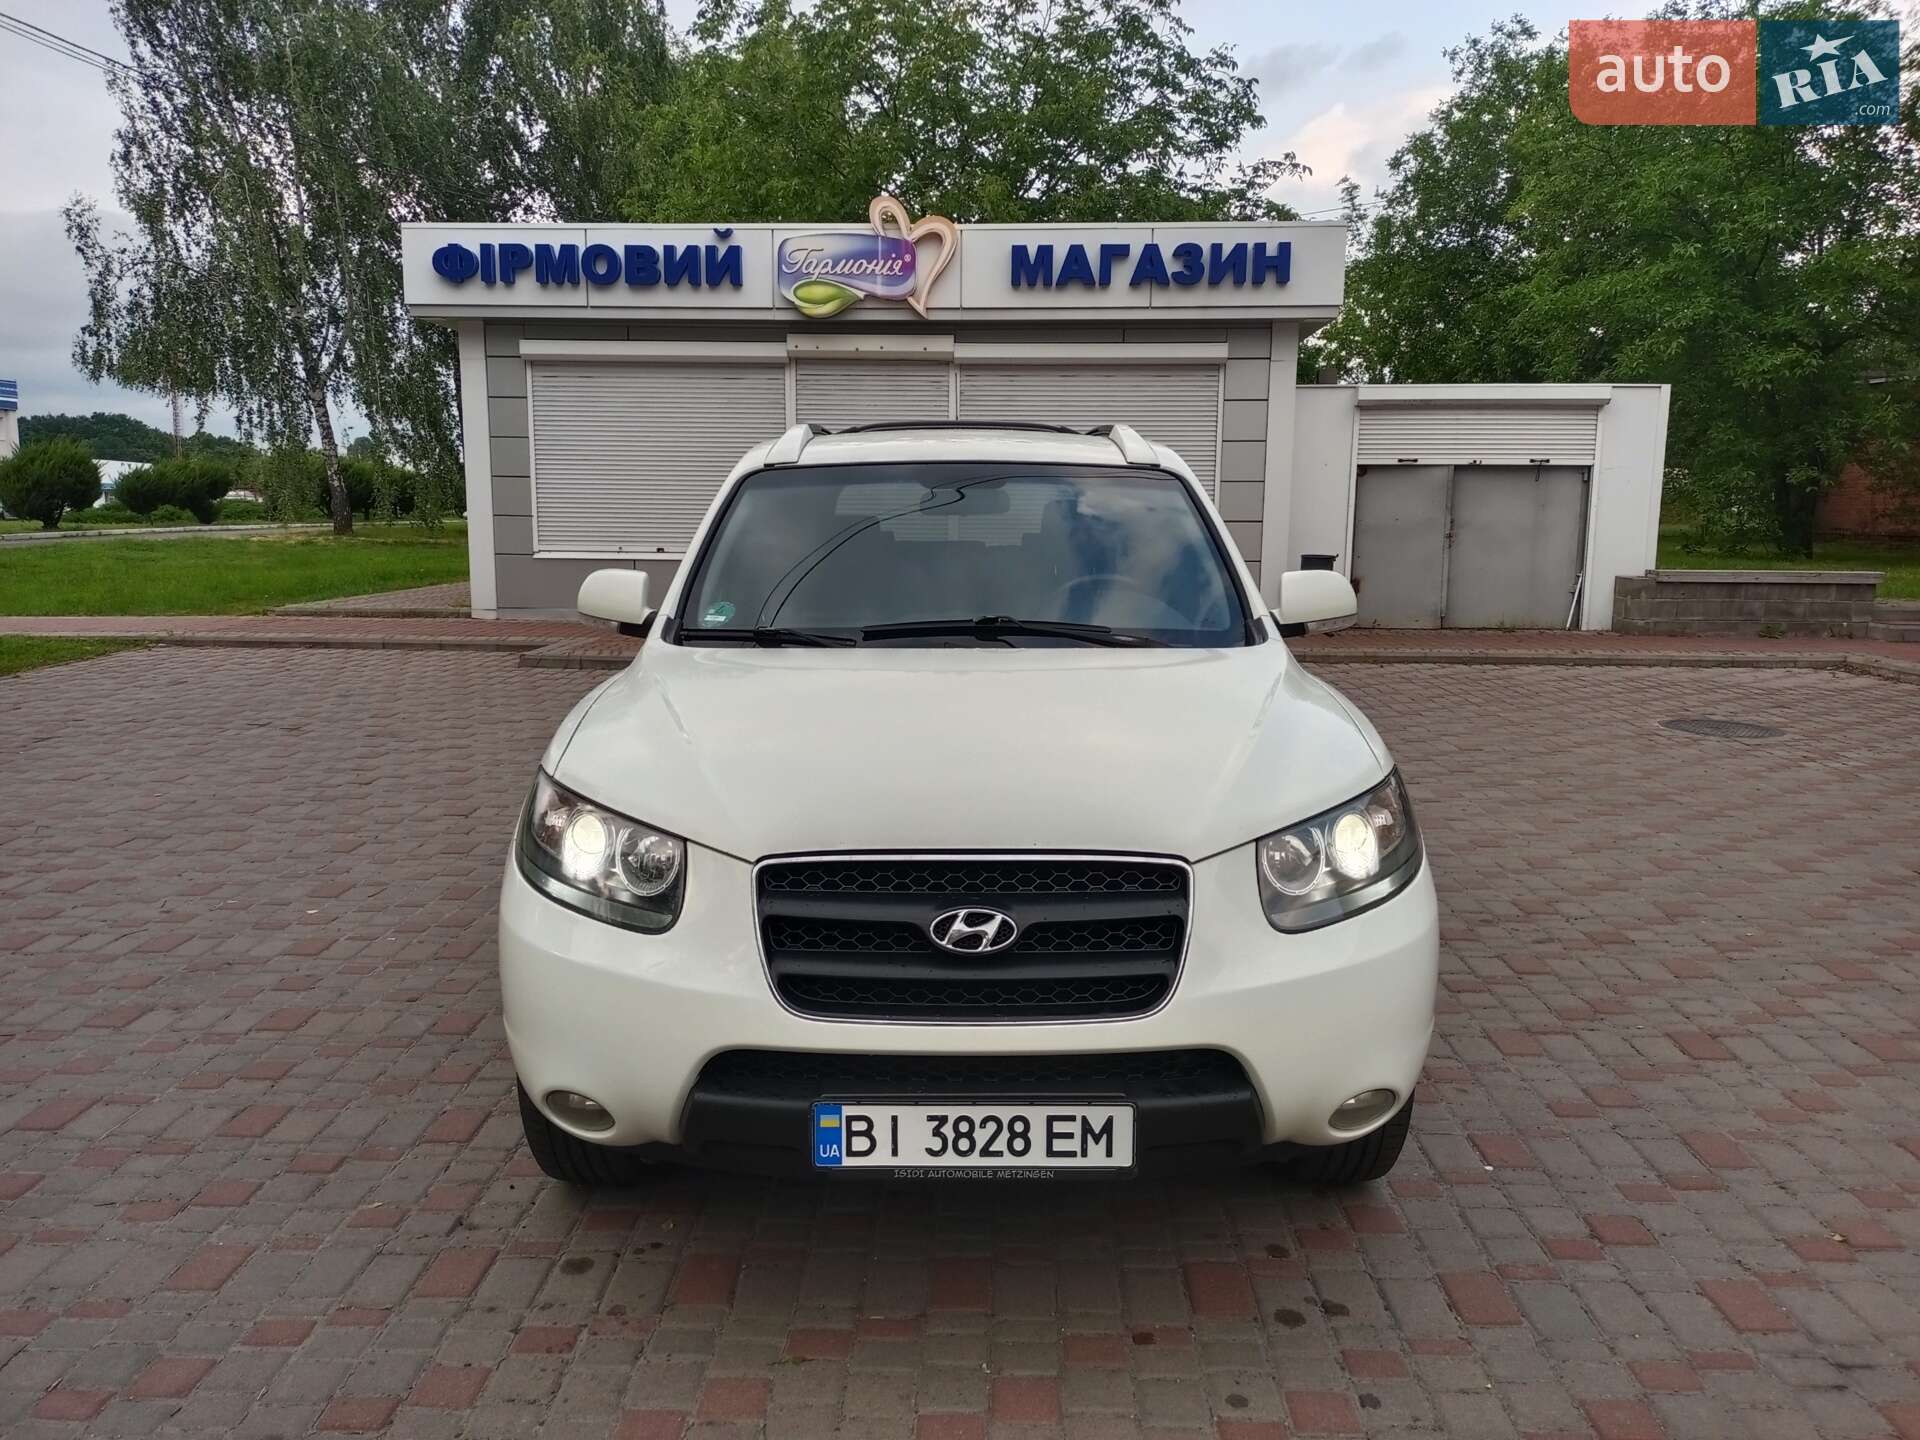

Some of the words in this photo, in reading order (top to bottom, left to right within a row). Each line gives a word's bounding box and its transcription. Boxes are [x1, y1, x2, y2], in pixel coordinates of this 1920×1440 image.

[432, 228, 743, 287] ФІРМОВИЙ
[1011, 242, 1292, 288] МАГАЗИН
[820, 1144, 840, 1157] UA
[924, 1115, 1031, 1157] 3828
[1046, 1115, 1113, 1157] EM
[928, 1169, 993, 1178] AUTOMOBILE
[996, 1170, 1054, 1178] METZINGEN
